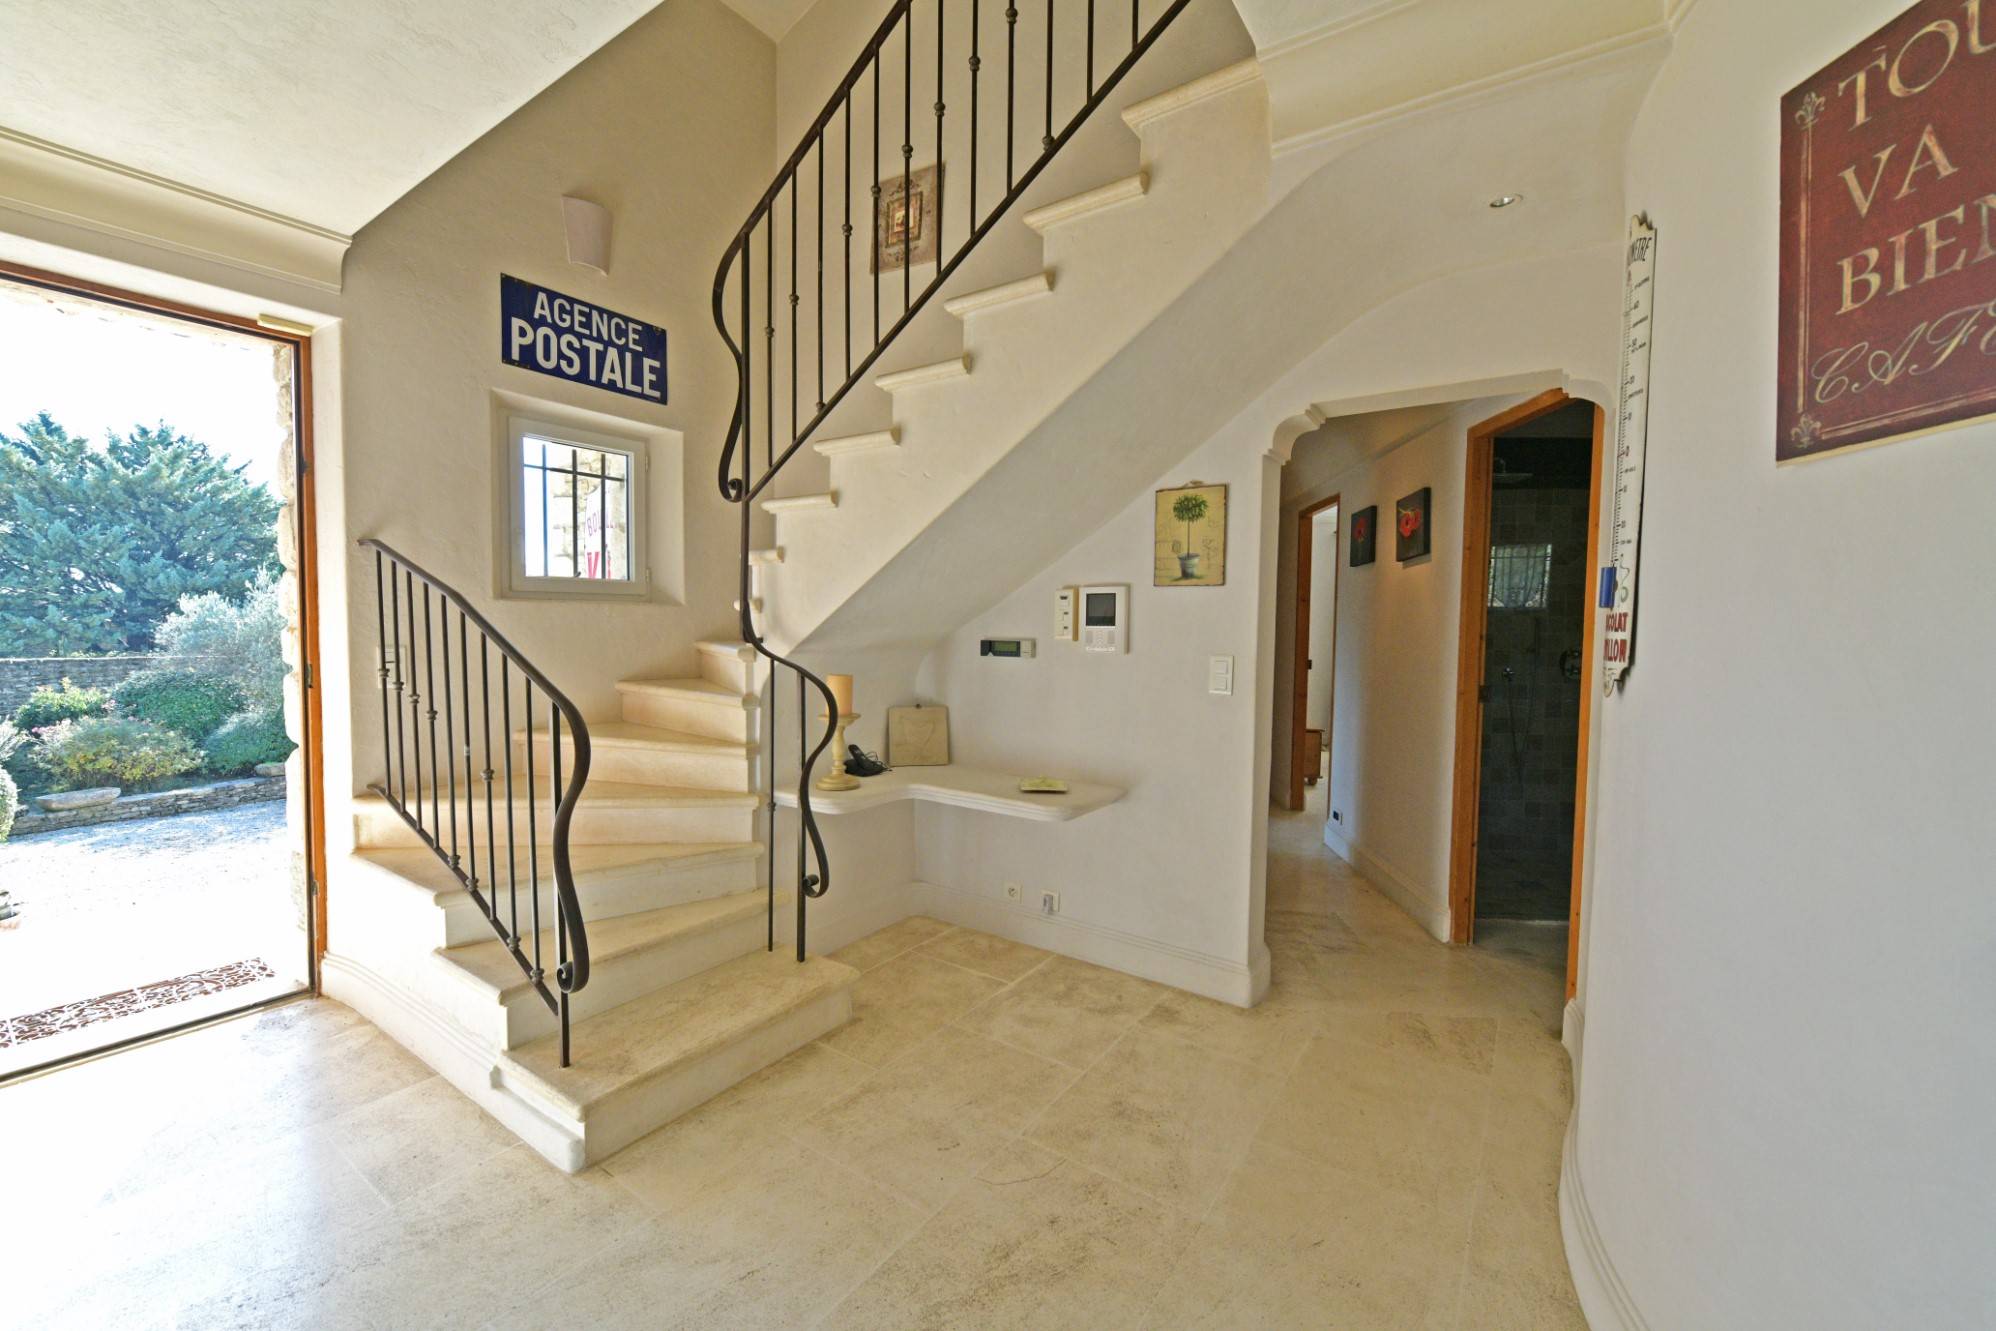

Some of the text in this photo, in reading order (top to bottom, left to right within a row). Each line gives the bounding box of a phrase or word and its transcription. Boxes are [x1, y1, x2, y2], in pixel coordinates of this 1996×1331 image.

[1838, 125, 1958, 218] VA
[511, 316, 661, 398] POSTALE
[533, 291, 643, 352] AGENCE
